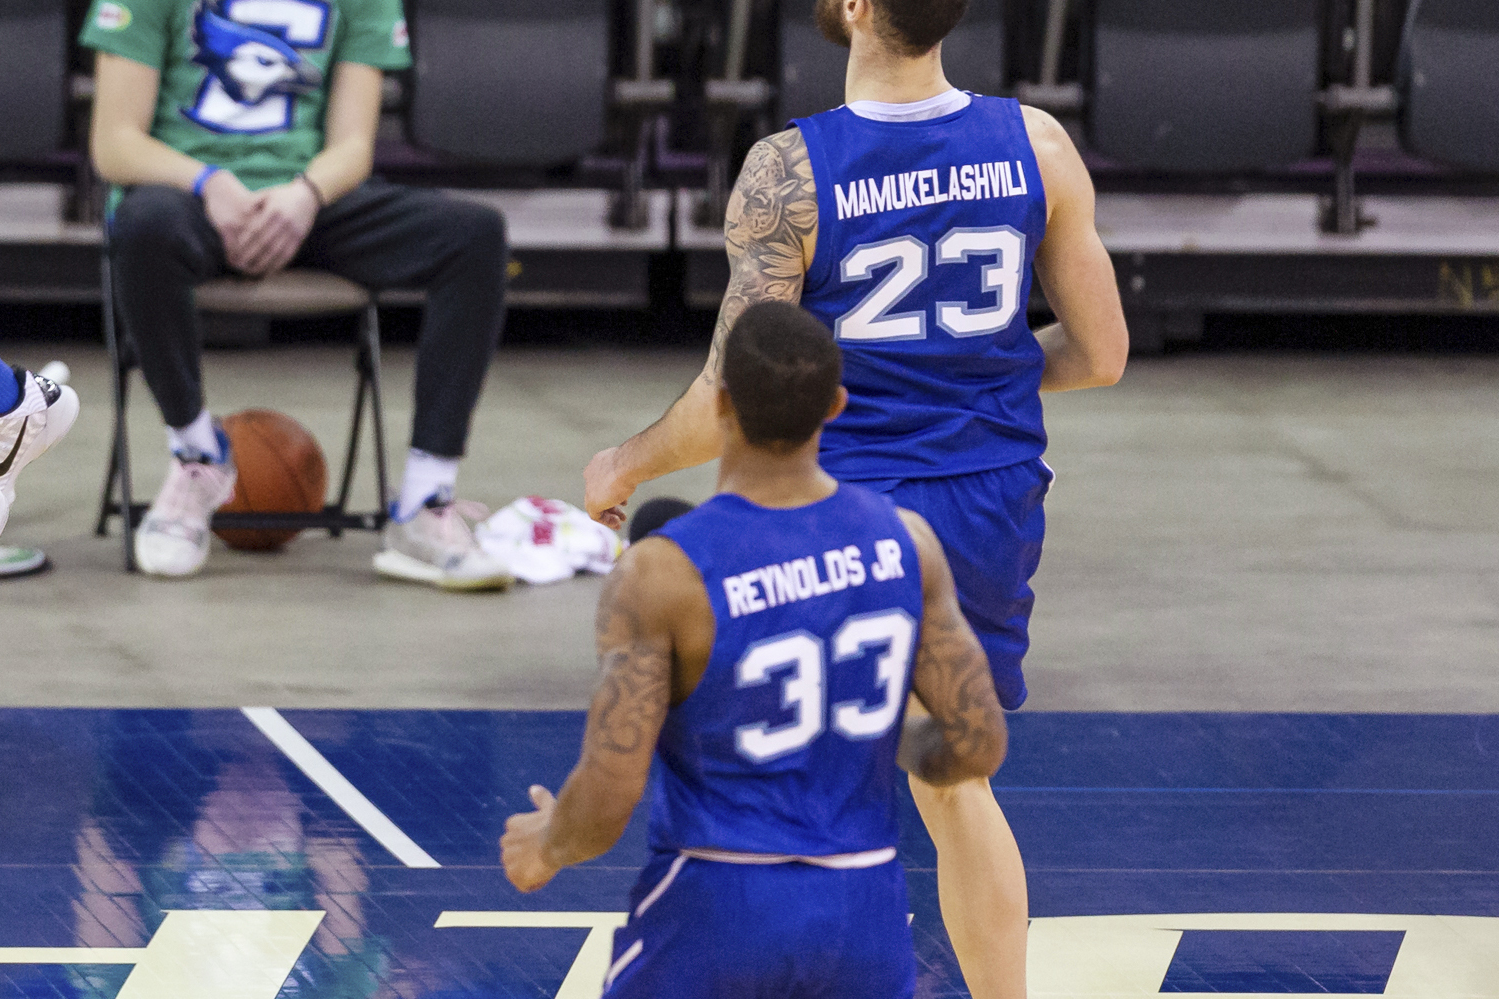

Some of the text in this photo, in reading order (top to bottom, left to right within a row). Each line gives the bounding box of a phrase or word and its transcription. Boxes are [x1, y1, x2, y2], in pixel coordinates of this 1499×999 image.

[834, 160, 1028, 220] MAMUKELASHVILI
[833, 224, 1027, 342] 23
[722, 538, 905, 619] REYNOLDS JR
[733, 606, 920, 765] 33
